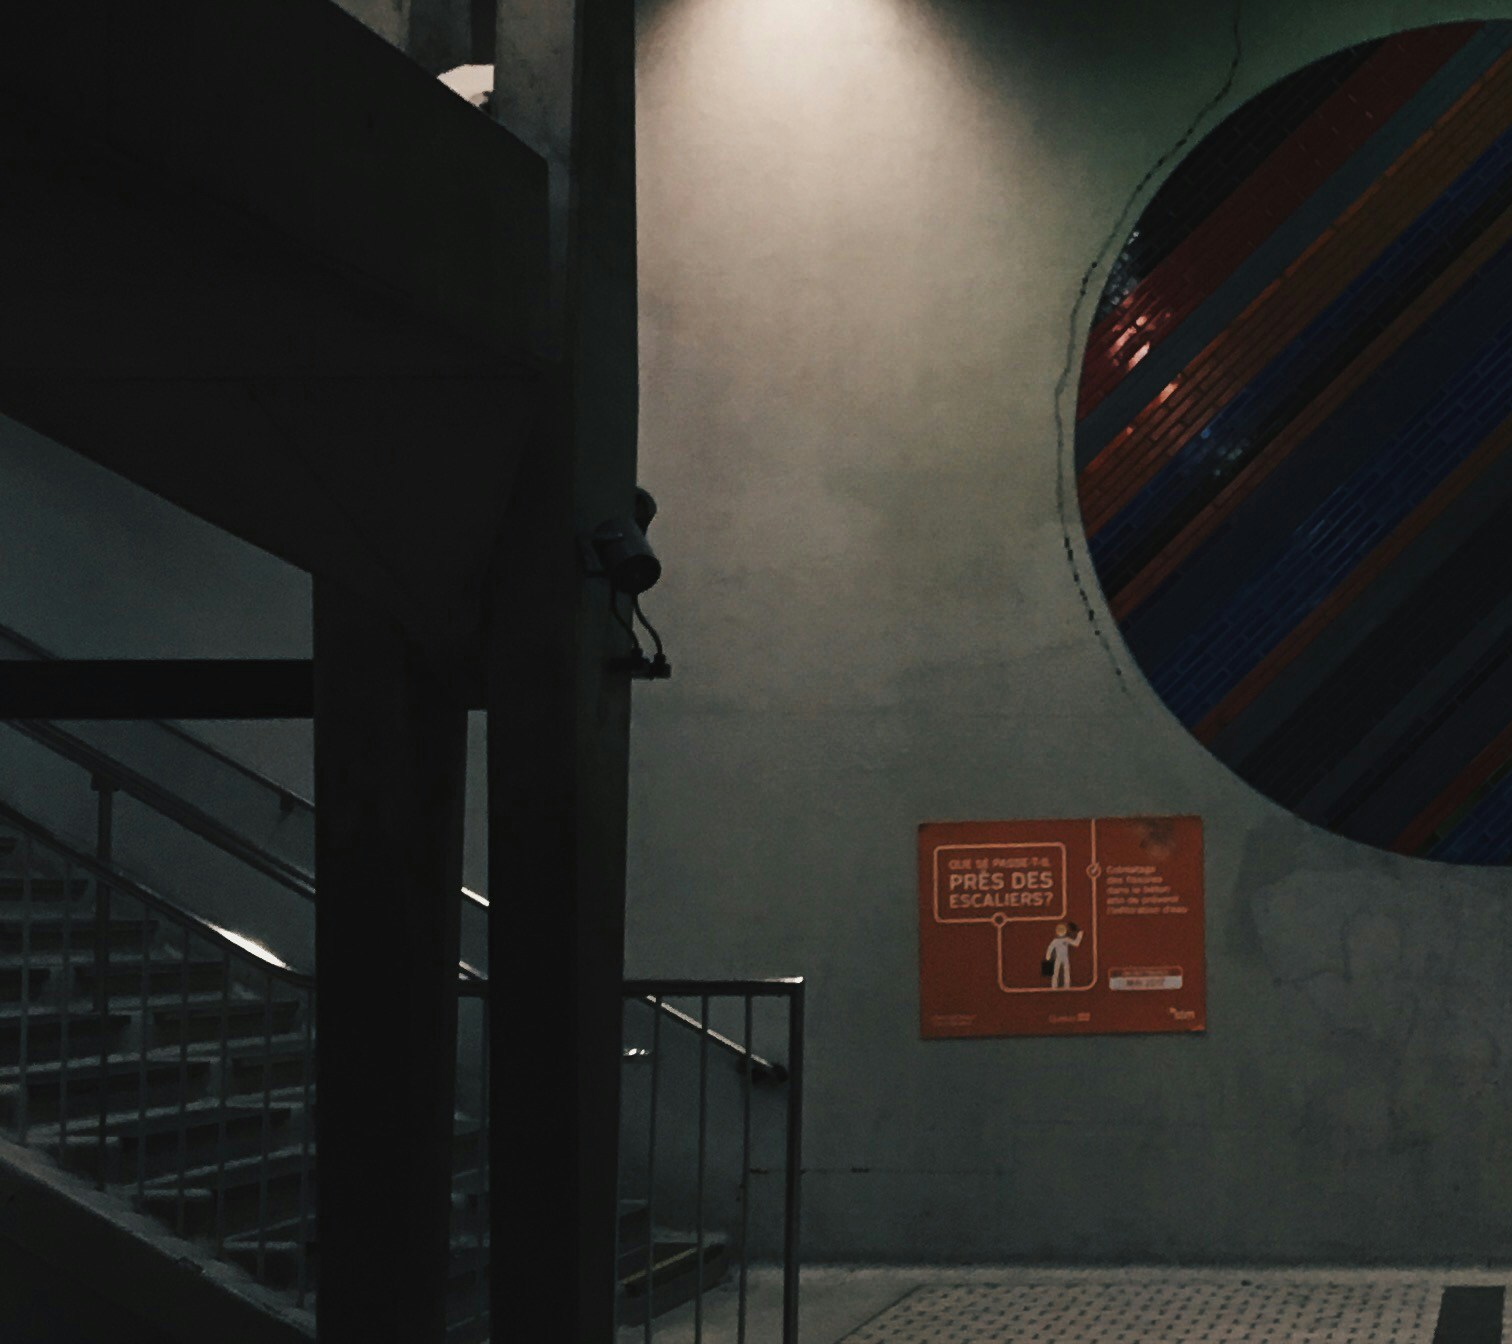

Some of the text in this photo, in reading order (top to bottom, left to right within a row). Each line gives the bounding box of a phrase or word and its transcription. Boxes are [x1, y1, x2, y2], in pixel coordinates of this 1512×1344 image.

[949, 870, 1054, 890] PRÈS DES
[949, 891, 1054, 909] ESCALIERS?
